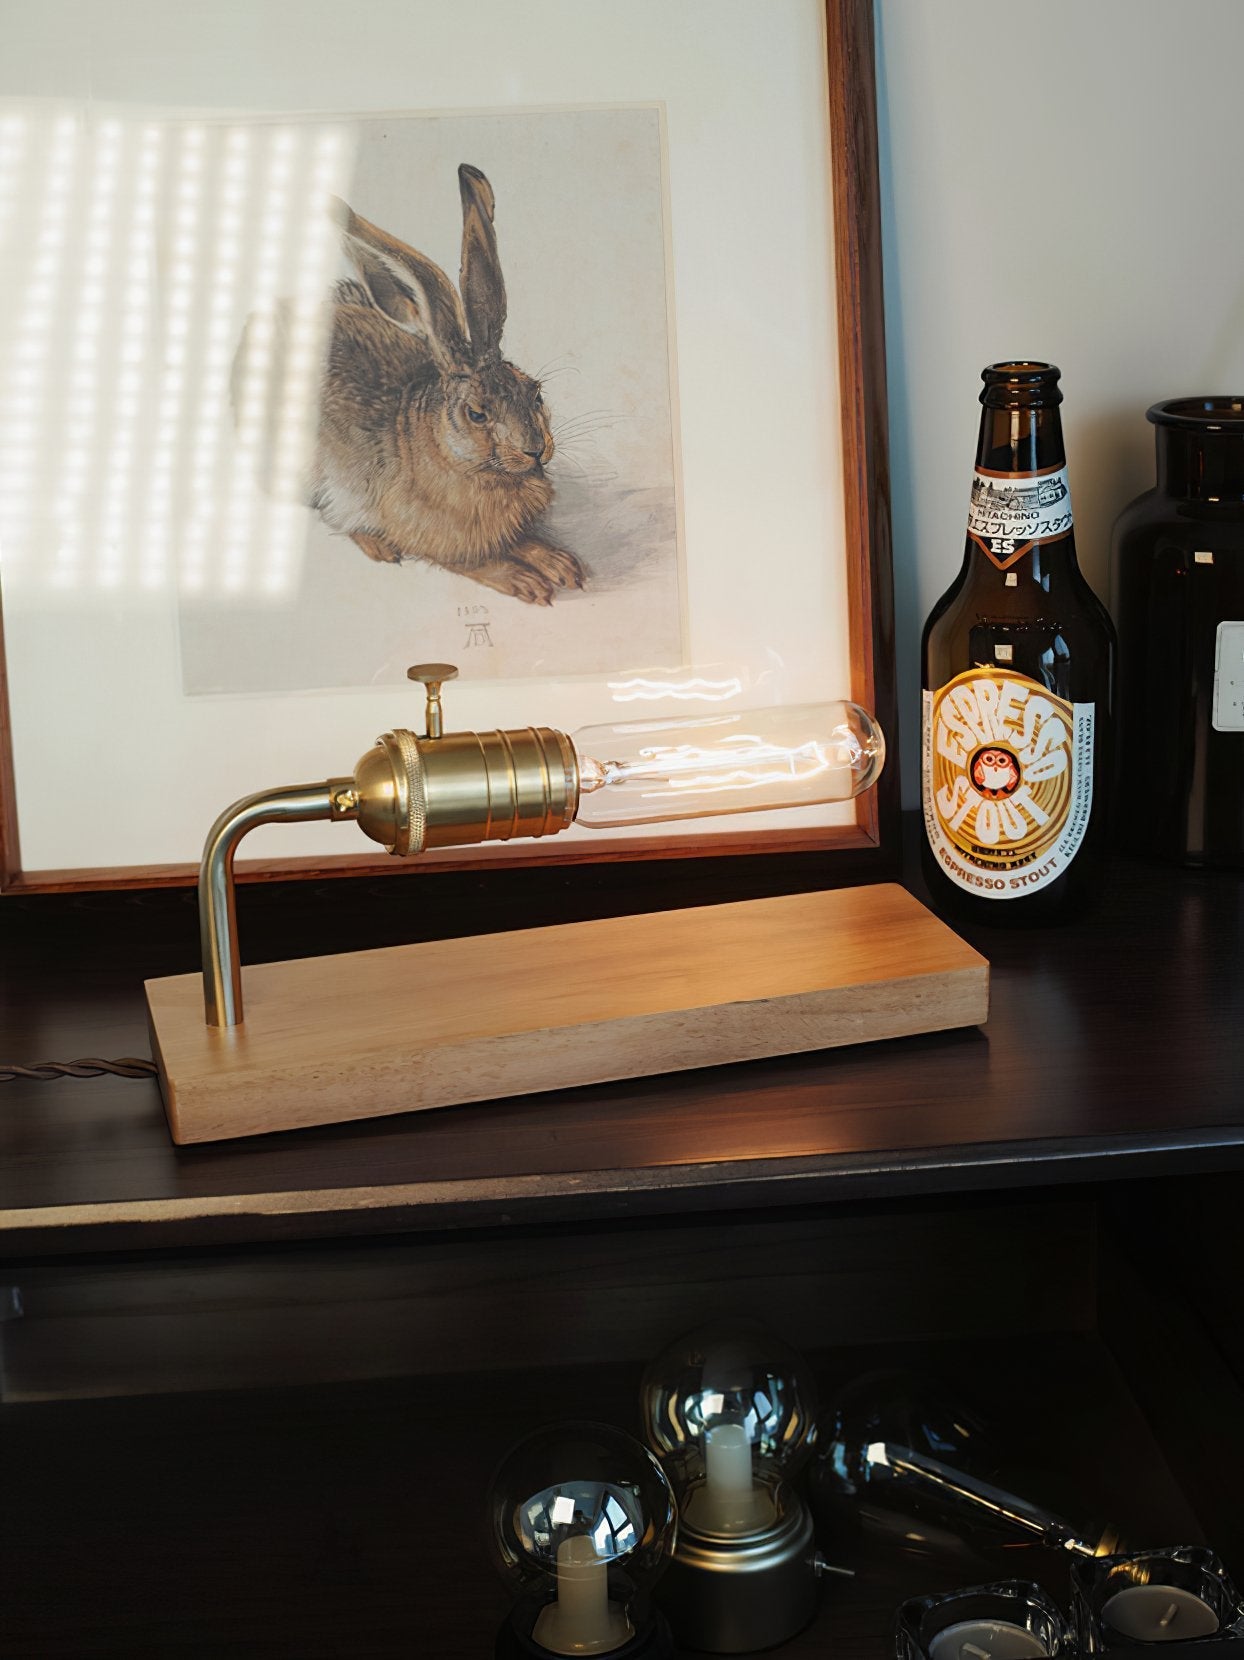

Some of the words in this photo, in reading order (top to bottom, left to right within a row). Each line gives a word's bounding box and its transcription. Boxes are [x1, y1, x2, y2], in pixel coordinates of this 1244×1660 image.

[990, 538, 1015, 554] ES
[937, 678, 1068, 783] ESPRESSO
[936, 774, 1050, 845] STOUT
[1009, 856, 1058, 889] STOUT
